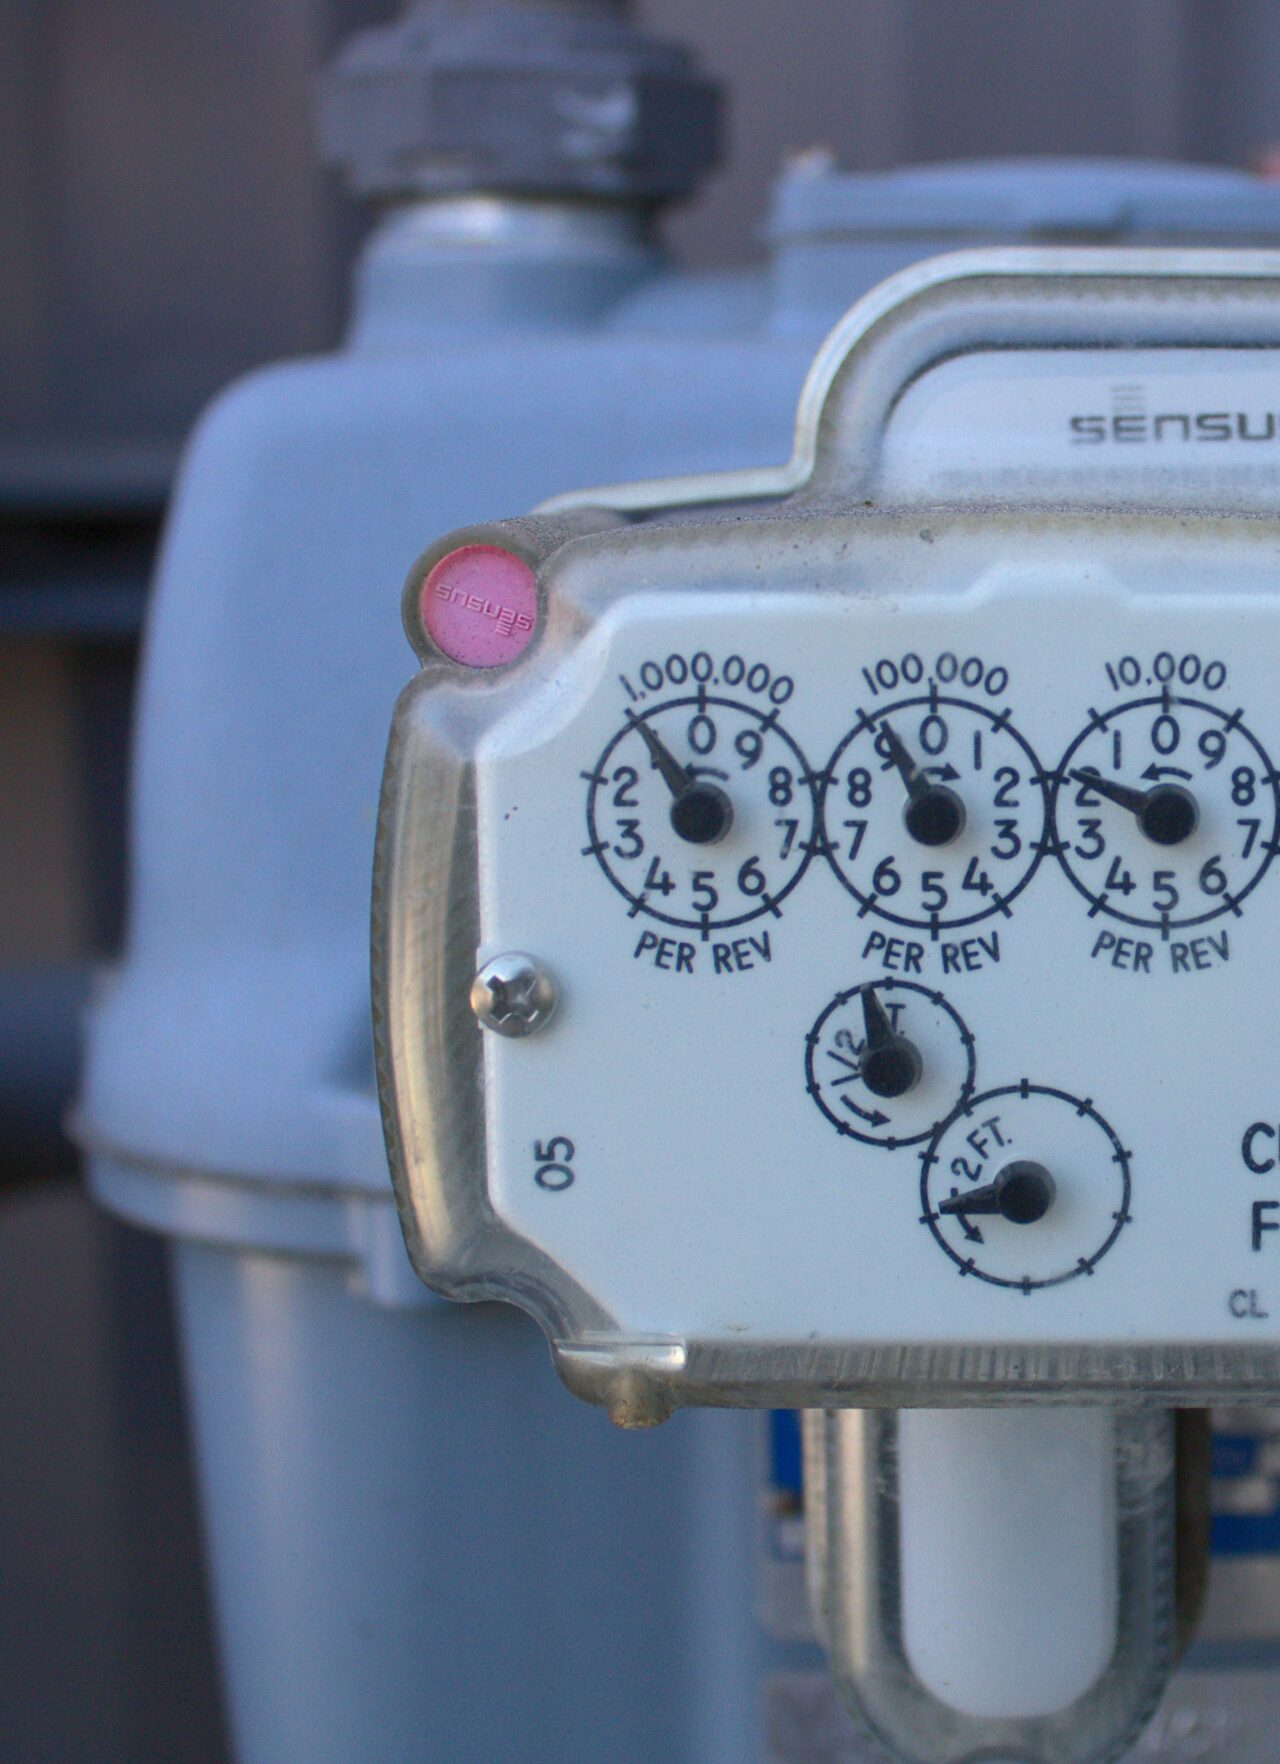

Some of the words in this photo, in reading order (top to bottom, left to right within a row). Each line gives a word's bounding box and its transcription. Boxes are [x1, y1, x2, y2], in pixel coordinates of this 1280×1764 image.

[688, 715, 716, 755] 0
[735, 730, 764, 770] 9
[919, 714, 948, 755] 0
[974, 730, 982, 770] 1
[1113, 730, 1121, 769] 1
[1151, 715, 1179, 755] 0
[1199, 730, 1226, 769] 9
[613, 766, 639, 807] 2
[769, 767, 793, 806] 8
[847, 768, 872, 807] 8
[994, 767, 1020, 807] 2
[1231, 767, 1255, 806] 8
[614, 819, 644, 859] 3
[775, 819, 798, 859] 7
[844, 819, 868, 860] 7
[991, 819, 1021, 859] 3
[1075, 819, 1105, 859] 3
[1236, 819, 1261, 859] 7
[644, 857, 675, 896] 4
[692, 871, 719, 911] 5
[738, 855, 765, 896] 6
[873, 855, 901, 896] 6
[921, 871, 948, 912] 5
[962, 857, 994, 896] 4
[1105, 856, 1136, 895] 4
[1153, 871, 1179, 911] 5
[1200, 855, 1228, 895] 6
[634, 931, 696, 973] PER
[713, 931, 771, 974] REV
[862, 932, 924, 973] PER
[942, 932, 1000, 974] REV
[1091, 930, 1153, 973] PER
[1170, 930, 1229, 973] REV
[966, 1116, 1013, 1159] FT.
[951, 1156, 983, 1182] 2
[1228, 1289, 1268, 1319] CL
